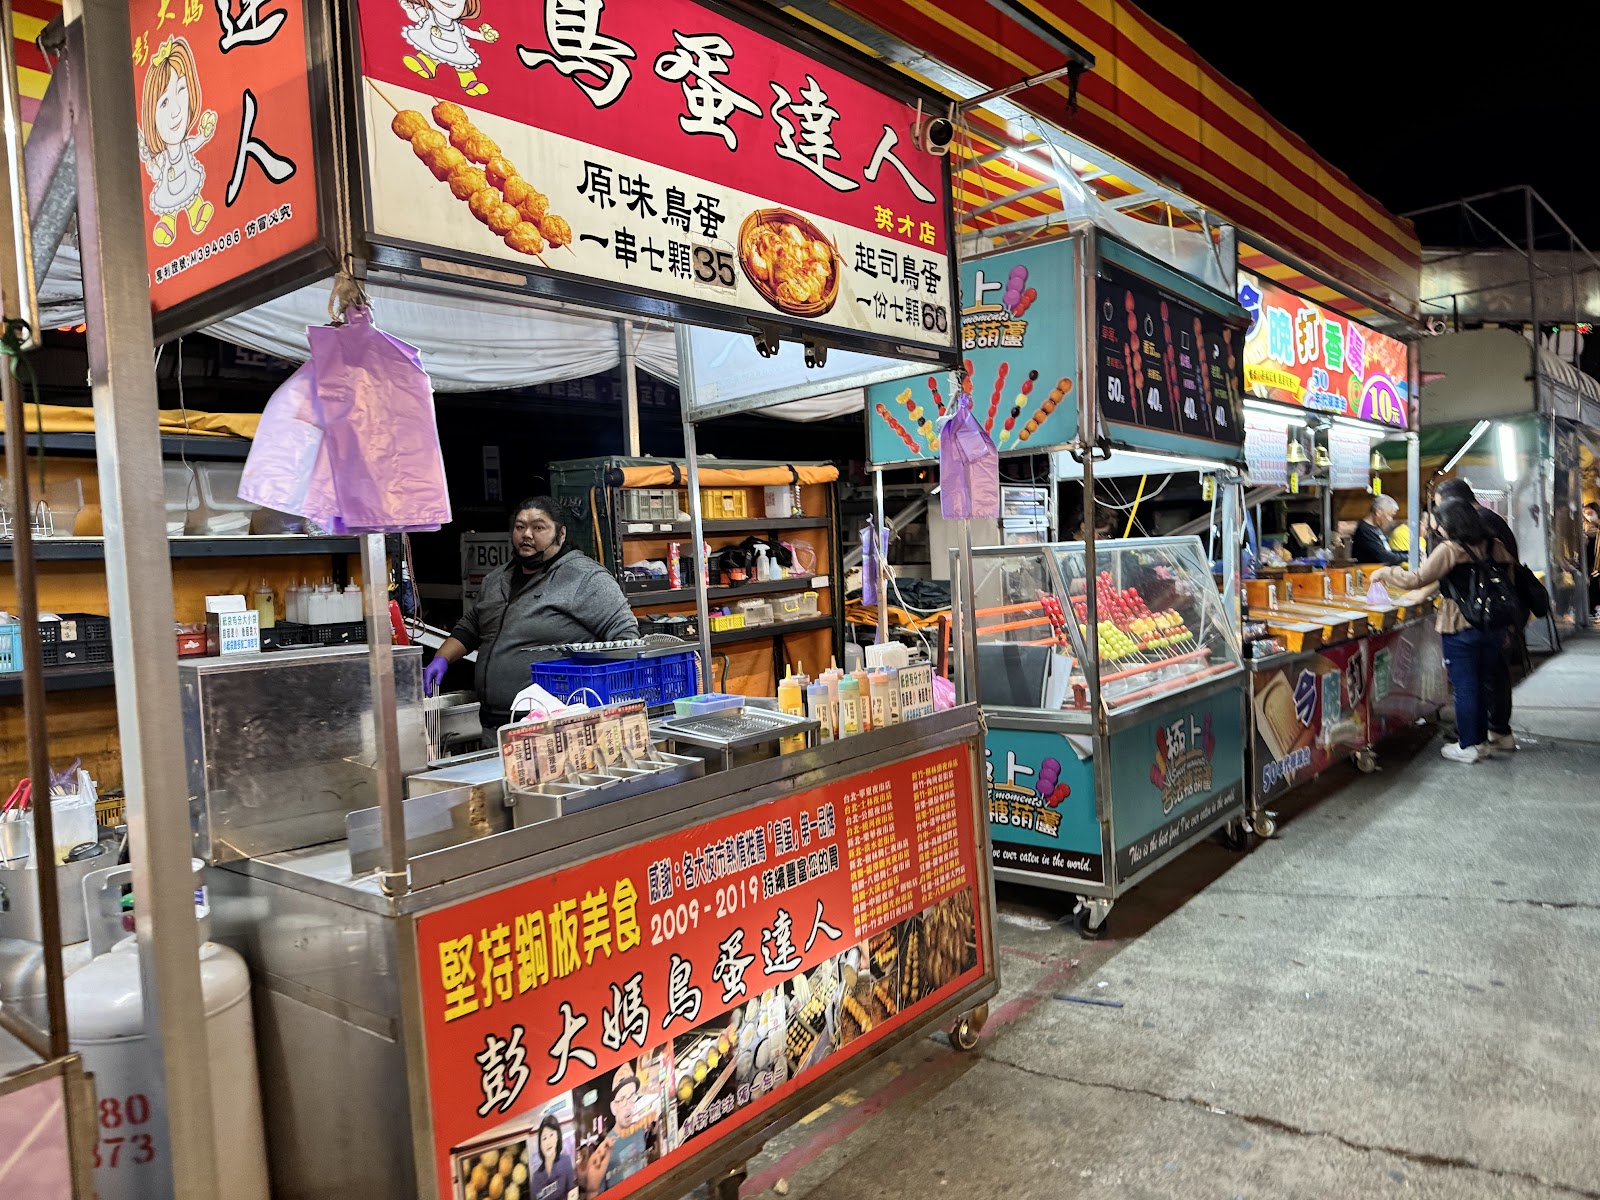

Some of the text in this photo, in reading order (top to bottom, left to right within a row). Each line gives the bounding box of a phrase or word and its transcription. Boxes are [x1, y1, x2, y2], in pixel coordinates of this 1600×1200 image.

[576, 160, 725, 238] 原味鳥蛋
[873, 205, 936, 246] 英才店
[854, 241, 942, 294] 起司鳥蛋
[1003, 850, 1017, 860] ever
[1020, 850, 1039, 865] eaten
[1042, 853, 1050, 865] in
[1053, 852, 1065, 868] the
[438, 877, 642, 1023] 堅持銅板美食
[475, 899, 843, 1117] 彭大媽鳥蛋達人
